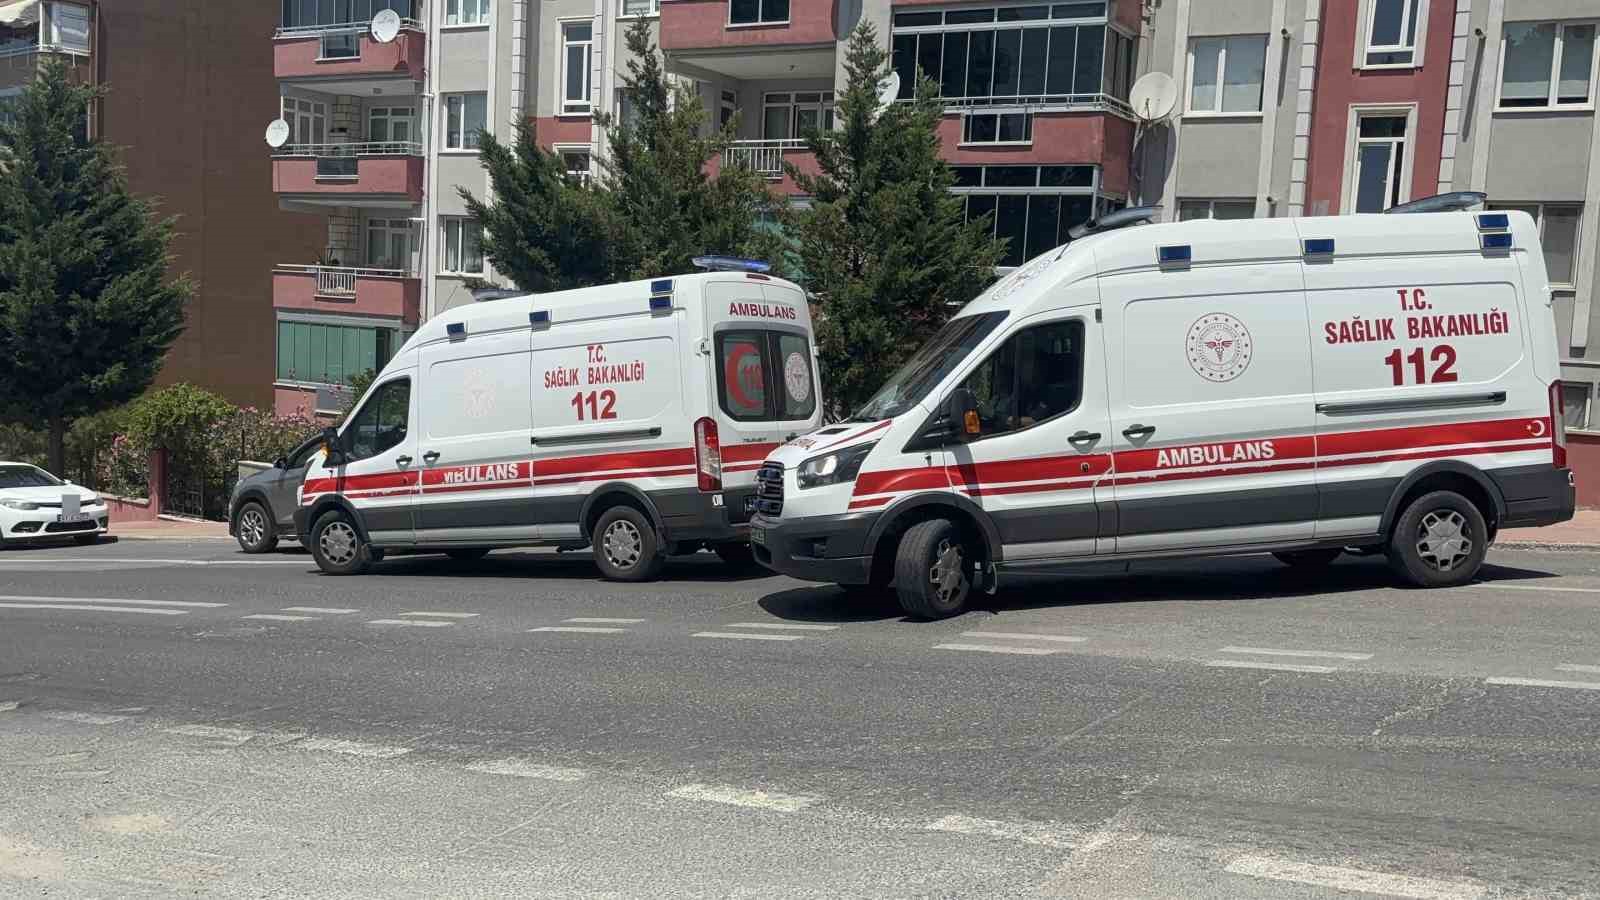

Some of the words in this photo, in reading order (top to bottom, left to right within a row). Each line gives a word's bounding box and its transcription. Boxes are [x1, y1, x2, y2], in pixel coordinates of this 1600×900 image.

[729, 302, 796, 320] AMBULANS
[1397, 288, 1433, 311] T.C.
[1324, 315, 1396, 344] SAĞLIK
[1407, 307, 1509, 339] BAKANLIĞI
[587, 344, 607, 363] T.C.
[1384, 344, 1458, 386] 112
[544, 366, 580, 389] SAĞLIK
[587, 359, 645, 385] BAKANLIĞI
[571, 389, 617, 421] 112
[1156, 440, 1275, 468] AMBULANS
